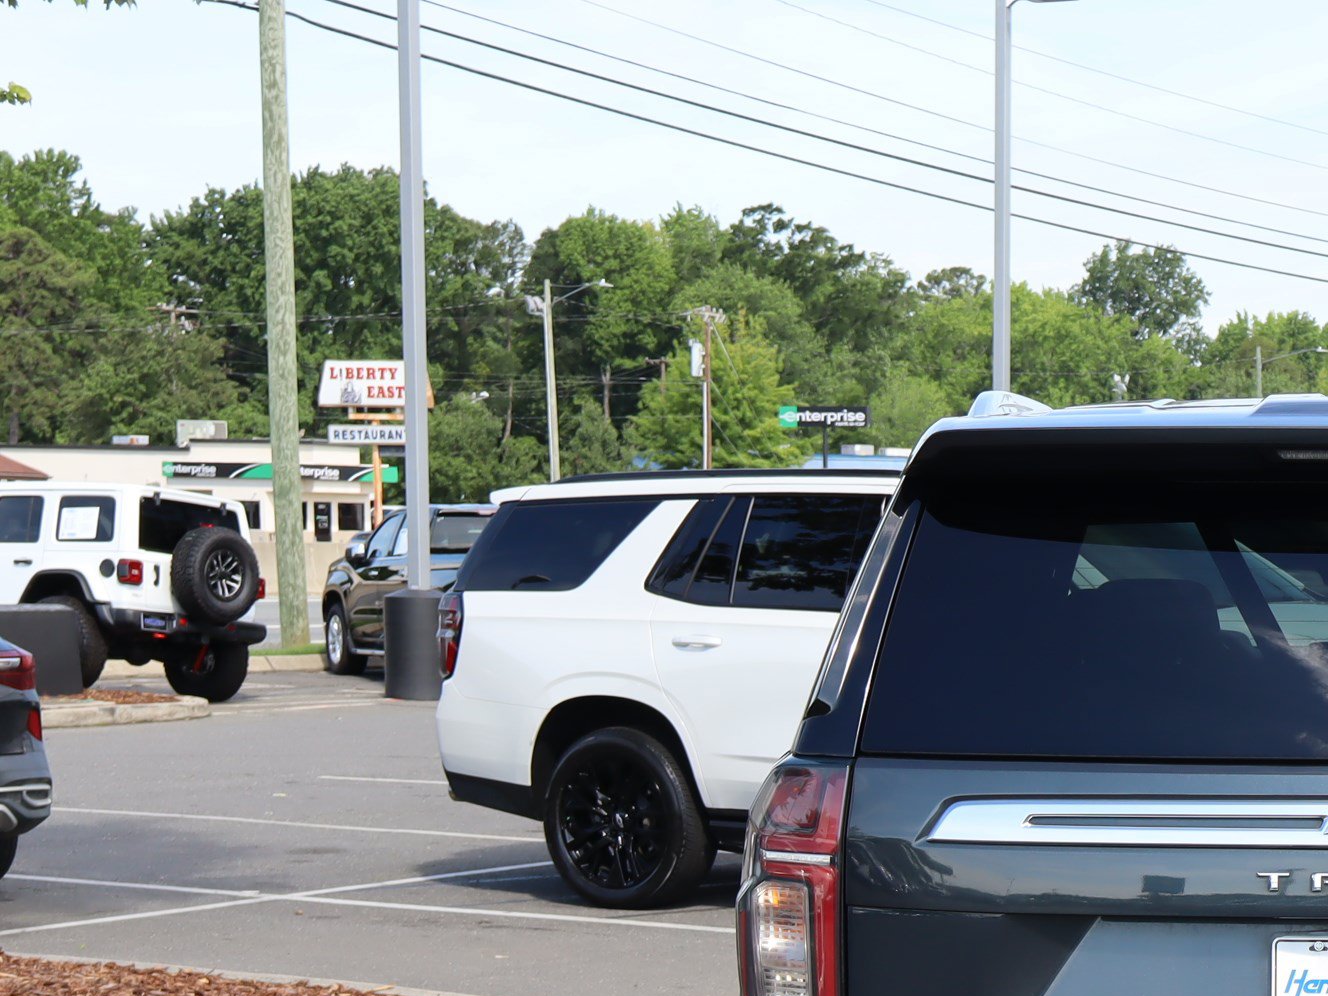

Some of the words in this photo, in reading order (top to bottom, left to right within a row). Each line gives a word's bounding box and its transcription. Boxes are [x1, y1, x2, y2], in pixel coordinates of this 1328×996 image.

[329, 366, 398, 380] LIBERTY
[367, 386, 405, 399] EAST
[780, 408, 866, 425] enterprise
[333, 430, 405, 441] RESTAURAN
[163, 463, 217, 476] enterprise
[299, 466, 340, 478] terprise
